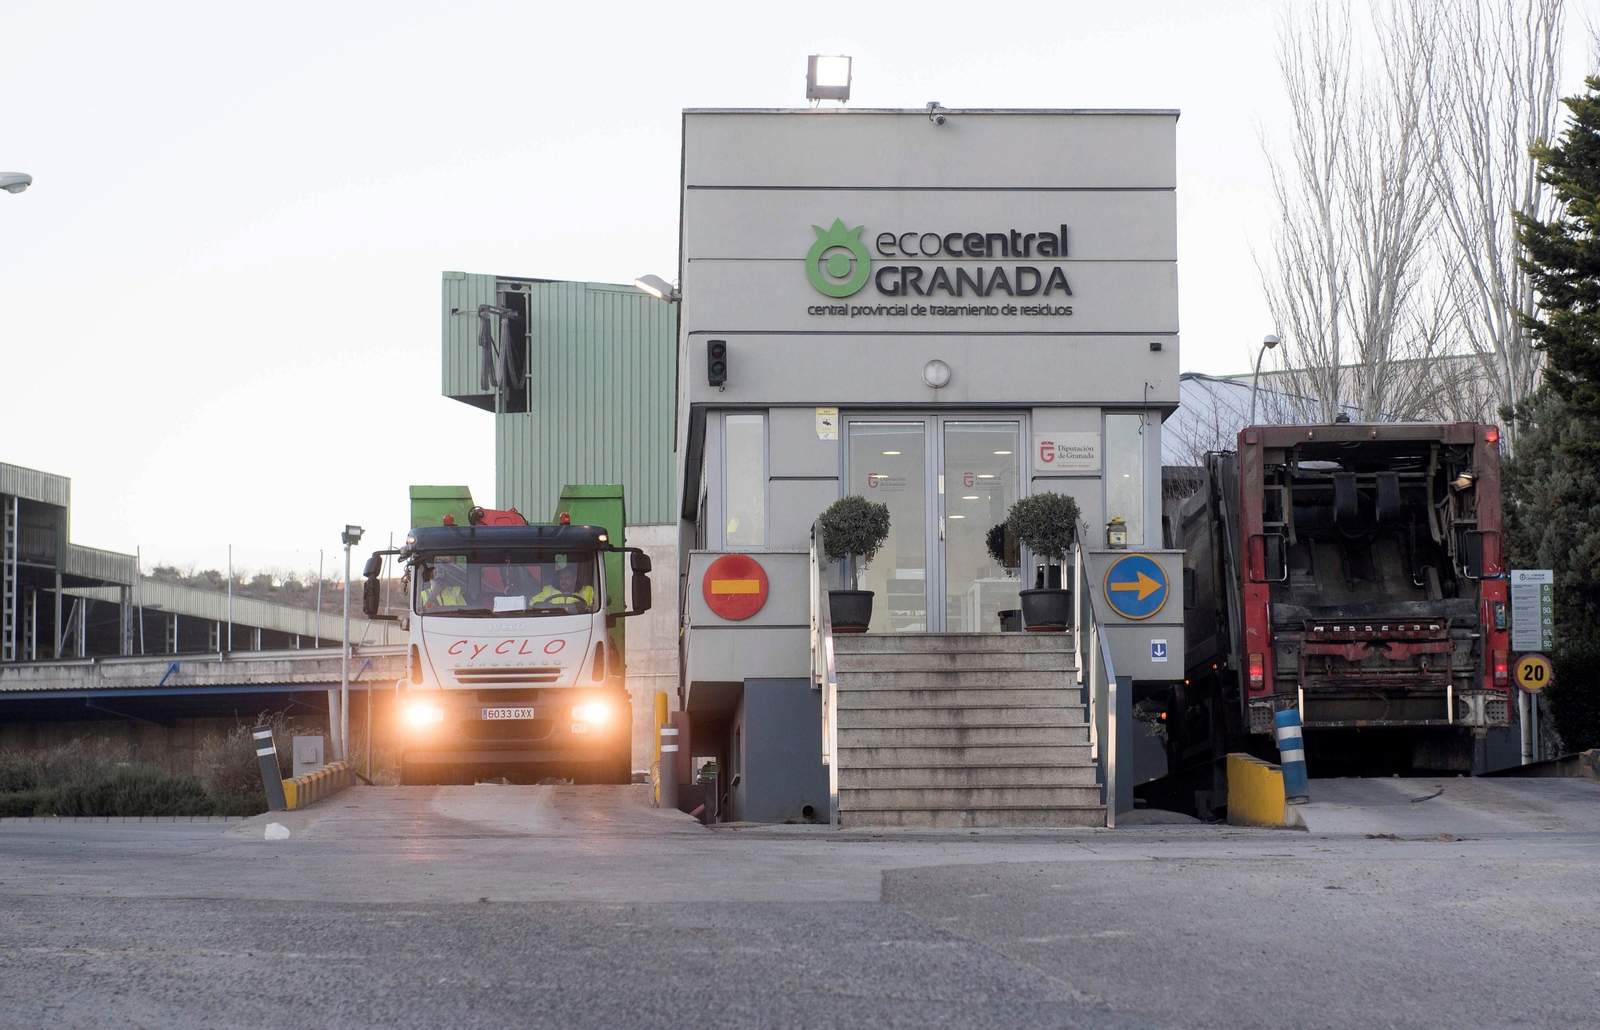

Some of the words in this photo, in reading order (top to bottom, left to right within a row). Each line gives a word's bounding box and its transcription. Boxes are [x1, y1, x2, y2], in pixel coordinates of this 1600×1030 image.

[876, 224, 1068, 257] ecocentral
[875, 266, 1073, 296] GRANADA
[807, 303, 848, 316] central
[851, 303, 908, 318] provincial
[910, 303, 927, 316] de
[930, 304, 998, 316] tratamiento
[1001, 303, 1017, 316] de
[1020, 303, 1073, 316] residuos
[1058, 445, 1094, 453] Diputación
[488, 622, 526, 632] IVECO
[1523, 664, 1544, 681] 20
[488, 709, 512, 719] 6033
[514, 709, 532, 719] GXX
